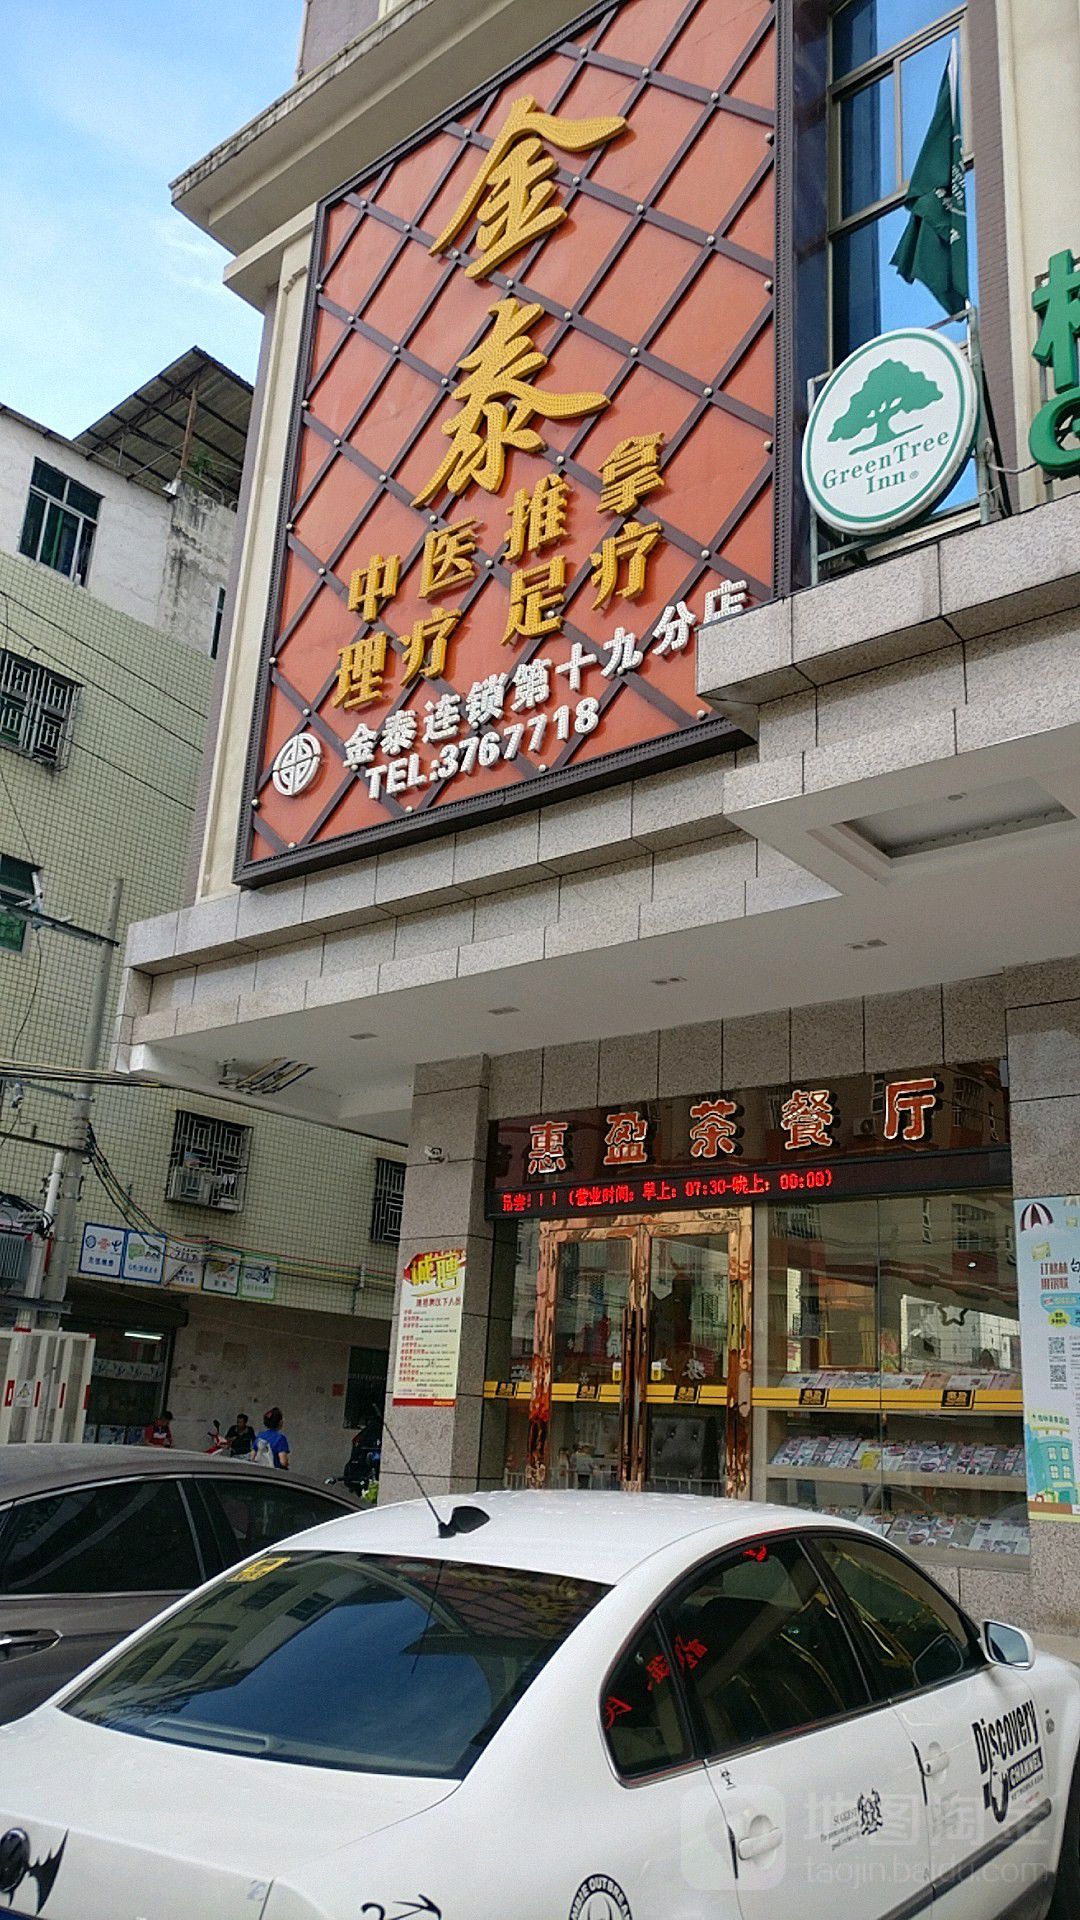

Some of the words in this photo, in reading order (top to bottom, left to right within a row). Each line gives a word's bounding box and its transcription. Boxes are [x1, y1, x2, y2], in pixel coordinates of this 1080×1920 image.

[411, 95, 629, 507] 金泰
[343, 579, 749, 768] 金泰连锁第十九分店
[366, 697, 600, 799] TEL:3767718
[528, 1077, 937, 1175] 惠盈茶餐厅
